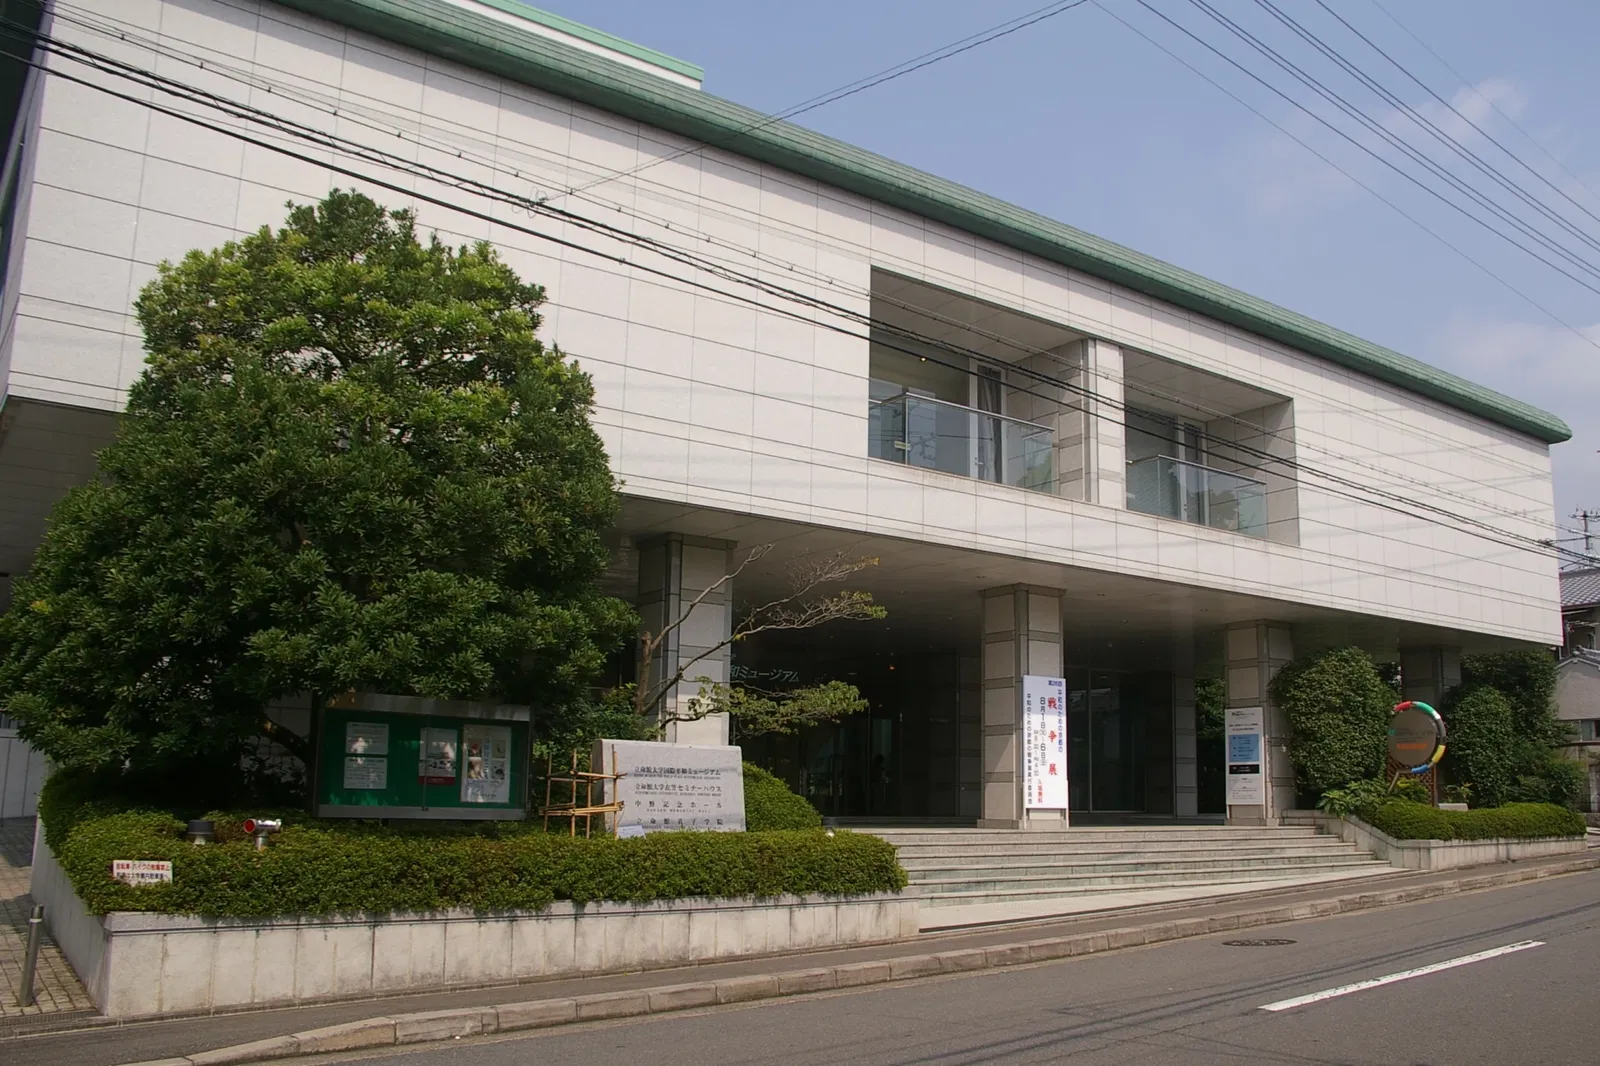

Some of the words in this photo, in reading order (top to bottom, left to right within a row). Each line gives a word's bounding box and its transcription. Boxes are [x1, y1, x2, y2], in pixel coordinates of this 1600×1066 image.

[1047, 697, 1058, 776] 戦争展
[635, 800, 722, 808] 中野記念ホール
